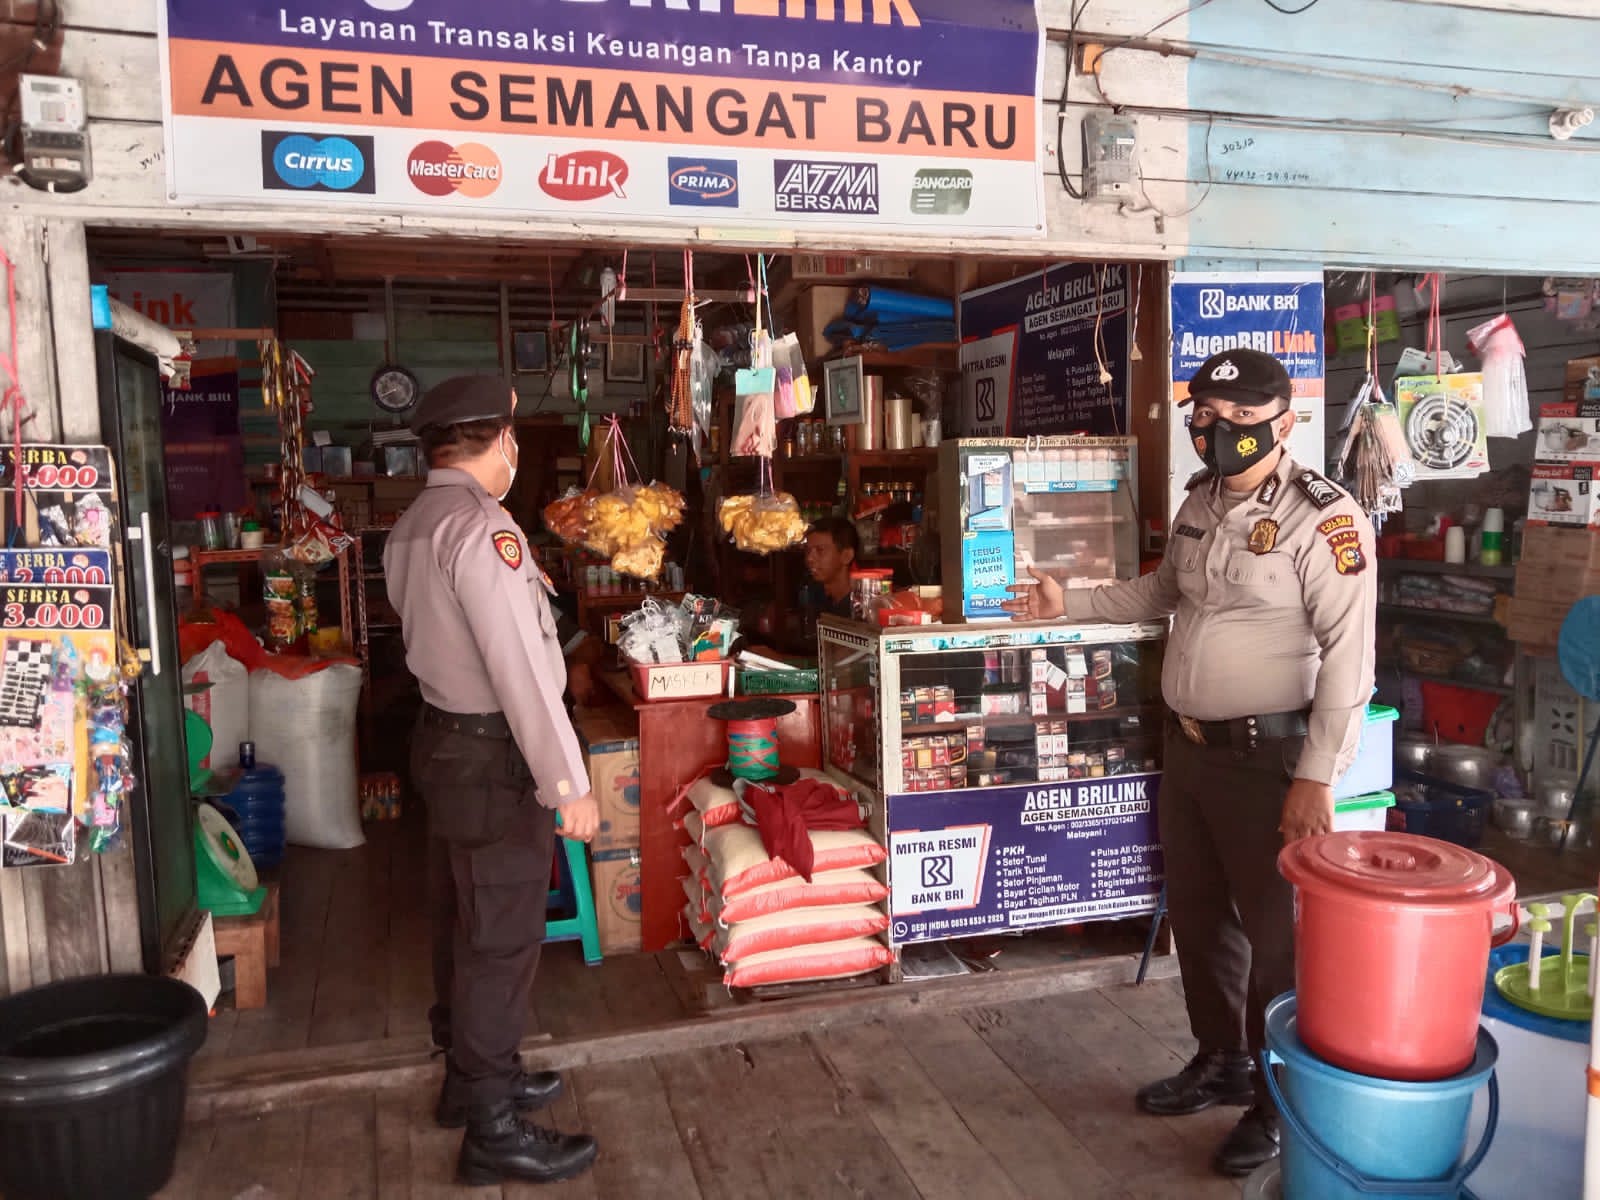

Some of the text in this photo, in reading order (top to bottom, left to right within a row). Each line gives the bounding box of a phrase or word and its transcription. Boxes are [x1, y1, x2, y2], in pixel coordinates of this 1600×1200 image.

[280, 8, 923, 77] Layanan Transaksi Keuangan Tanpa Kantor
[200, 54, 1017, 151] AGEN SEMANGAT BARU
[284, 151, 353, 174] Cirrus
[409, 160, 499, 181] MasterCard
[546, 156, 627, 199] Link
[677, 174, 731, 191] PRIMA
[776, 163, 878, 196] ATM
[912, 176, 973, 190] BANKCARD
[776, 194, 878, 212] BERSAMA
[1025, 284, 1062, 313] AGEN
[1226, 295, 1299, 311] BANK BRI
[113, 292, 195, 326] ink
[1028, 314, 1049, 329] AGEN
[1096, 294, 1120, 311] ARU
[1331, 532, 1357, 543] RIAU
[16, 553, 66, 568] SERBA
[7, 589, 71, 604] SERBA
[3, 603, 104, 628] 3.000
[1024, 781, 1147, 811] AGEN BRILINK
[1023, 801, 1149, 823] AGEN SEMANGAT BARU
[896, 837, 977, 855] MITRA RESMI
[1003, 845, 1025, 856] PKH
[1097, 848, 1119, 857] Pulsa
[1120, 846, 1130, 855] All
[1003, 853, 1047, 867] Setor Tunai
[1097, 855, 1142, 868] Bayar BPJS
[1003, 864, 1046, 877] Tarik Tunai
[1098, 864, 1151, 879] Bayar Tagihan
[1003, 874, 1063, 888] Setor Pinjaman
[1098, 876, 1136, 889] Registrasi
[911, 889, 964, 905] BANK BRI
[1003, 882, 1080, 899] Bayar Cicilan Motor
[1098, 888, 1126, 898] T-Bank
[1004, 892, 1078, 910] Bayar Tagihan PLN
